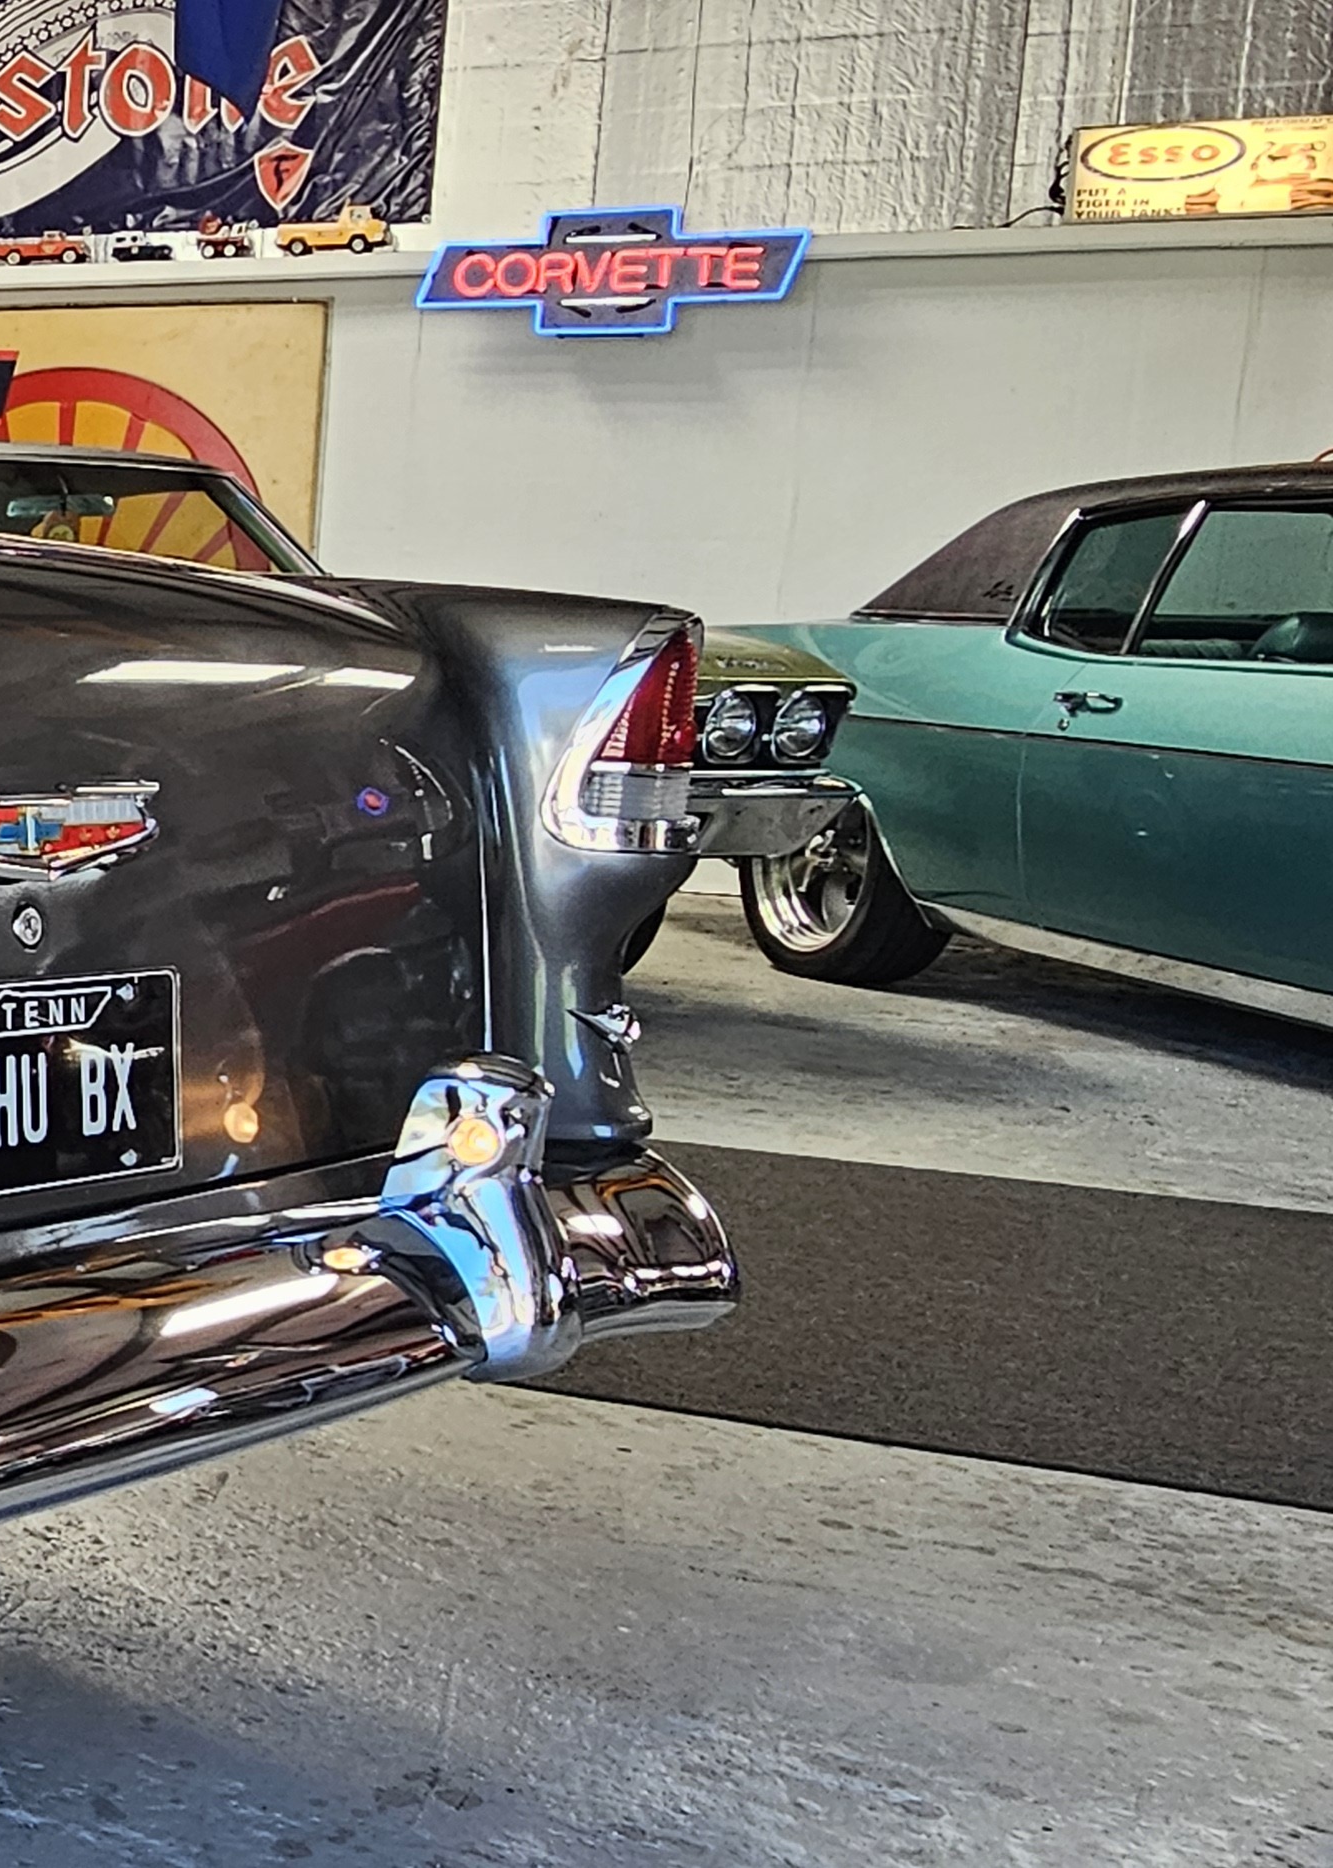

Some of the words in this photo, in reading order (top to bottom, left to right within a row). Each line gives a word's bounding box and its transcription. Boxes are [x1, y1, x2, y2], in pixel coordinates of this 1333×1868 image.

[1107, 142, 1221, 166] Esso
[1076, 187, 1109, 198] PUT
[1117, 187, 1127, 197] A
[1076, 199, 1126, 209] TIGER
[1134, 199, 1150, 207] IN
[1075, 210, 1122, 220] YOUR
[453, 246, 765, 298] CORVETTE
[1, 997, 86, 1030] TENN
[80, 1042, 137, 1136] BX
